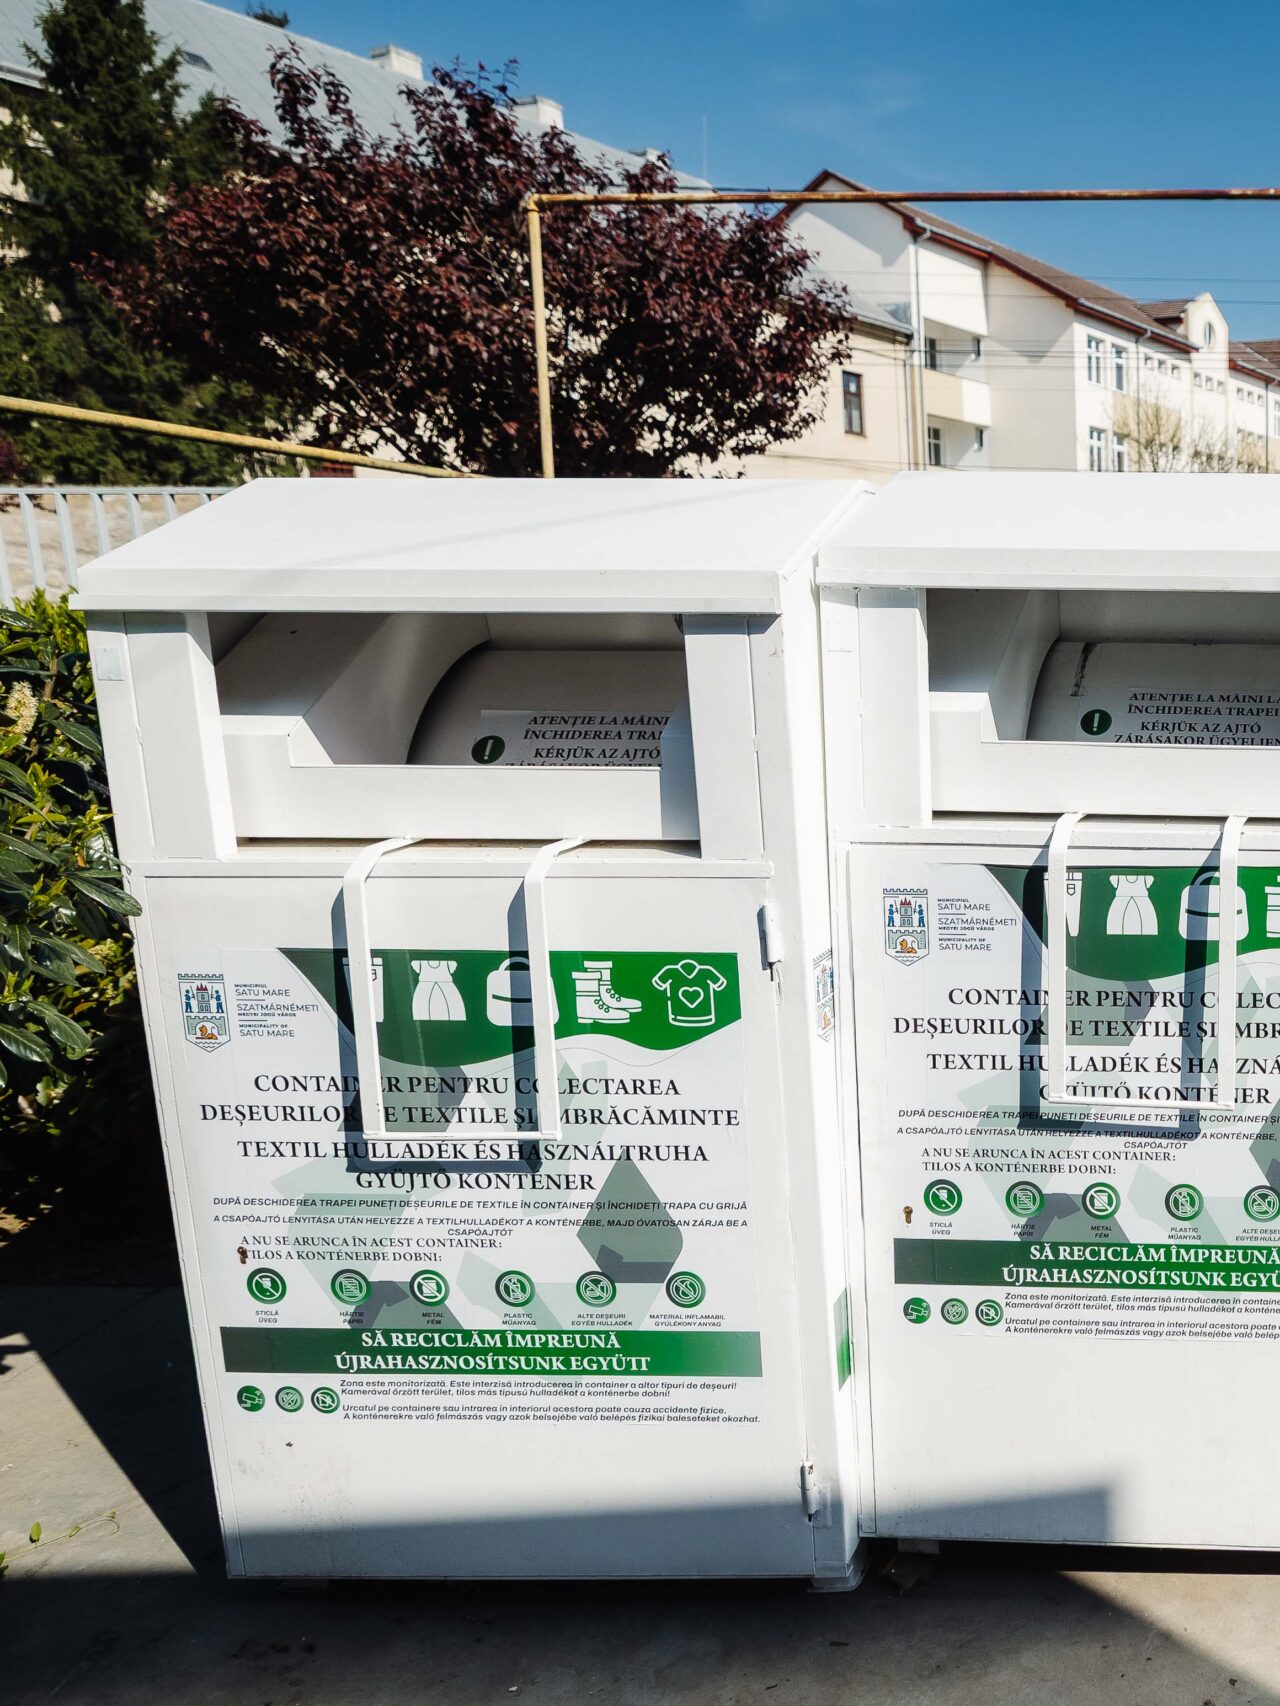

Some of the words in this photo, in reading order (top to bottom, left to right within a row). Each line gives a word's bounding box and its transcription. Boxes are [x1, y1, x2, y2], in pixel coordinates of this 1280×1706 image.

[1198, 694, 1215, 702] LA
[1218, 694, 1262, 703] MÂINI
[1128, 702, 1222, 715] ÎNCHIDEREA
[599, 716, 618, 725] LA
[1141, 720, 1198, 734] KÉRJÜK
[1201, 723, 1220, 732] AZ
[1224, 721, 1261, 736] AJTÓ
[523, 729, 622, 740] ÎNCHIDEREA
[533, 746, 594, 761] KÉRJÜK
[596, 749, 617, 758] AZ
[621, 746, 660, 761] AJTÓ
[938, 901, 961, 910] SATU
[964, 901, 990, 911] MARE
[938, 915, 1017, 926] SZATMÁRNÉMETI
[237, 1000, 319, 1012] SZATMÁRNÉMETI
[1096, 990, 1194, 1008] PENTRU
[894, 1018, 1045, 1043] DEȘEURILOR
[1092, 1020, 1190, 1037] TEXTILE
[1197, 1022, 1216, 1043] ȘI
[927, 1054, 1013, 1070] TEXTIL
[1019, 1053, 1154, 1073] HULADÉK
[1159, 1053, 1182, 1073] ÉS
[409, 1077, 509, 1094] PENTRU
[200, 1104, 358, 1130] DEȘEURILOR
[403, 1107, 508, 1123] TEXTILE
[514, 1108, 534, 1131] ȘI
[560, 1105, 739, 1126] MBRĂCĂMINTE
[237, 1141, 326, 1157] TEXTIL
[332, 1136, 469, 1159] HULLADÉK
[473, 1138, 500, 1159] ÉS
[507, 1139, 708, 1161] HASZNÁLTRUHA
[922, 1148, 929, 1156] A
[934, 1148, 952, 1157] NU
[955, 1148, 969, 1157] SE
[973, 1149, 1028, 1158] ARUNCA
[1032, 1148, 1044, 1158] ÎN
[1048, 1150, 1089, 1159] ACEST
[1093, 1151, 1175, 1161] CONTAINER:
[922, 1162, 960, 1171] TILOS
[964, 1163, 972, 1171] A
[976, 1161, 1065, 1173] KONTÉNERBE
[1069, 1165, 1115, 1174] DOBNI:
[356, 1170, 451, 1193] GYÜJTŐ
[459, 1171, 596, 1190] KONTÉNER
[214, 1196, 241, 1205] DUPĂ
[244, 1198, 317, 1206] DESCHIDEREA
[663, 1202, 696, 1210] TRAPA
[716, 1201, 747, 1210] GRIJĂ
[241, 1236, 249, 1244] A
[253, 1236, 271, 1245] NU
[275, 1236, 290, 1245] SE
[293, 1237, 349, 1246] ARUNCA
[353, 1236, 366, 1246] ÎN
[370, 1238, 412, 1247] ACEST
[416, 1238, 502, 1248] CONTAINER:
[286, 1250, 294, 1259] A
[297, 1249, 390, 1261] KONTÉNERBE
[393, 1252, 441, 1261] DOBNI:
[1030, 1243, 1055, 1260] SĂ
[1058, 1246, 1166, 1262] RECICLĂM
[1002, 1264, 1226, 1286] ÚJRAHASZNOSÍTSUNK
[362, 1330, 388, 1346] SĂ
[390, 1329, 502, 1347] RECICLĂM
[506, 1329, 621, 1348] ÎMPREUNĂ
[334, 1352, 566, 1374] ÚJRAHASZNOSÍTSUNK
[570, 1354, 650, 1370] EGYÜTT
